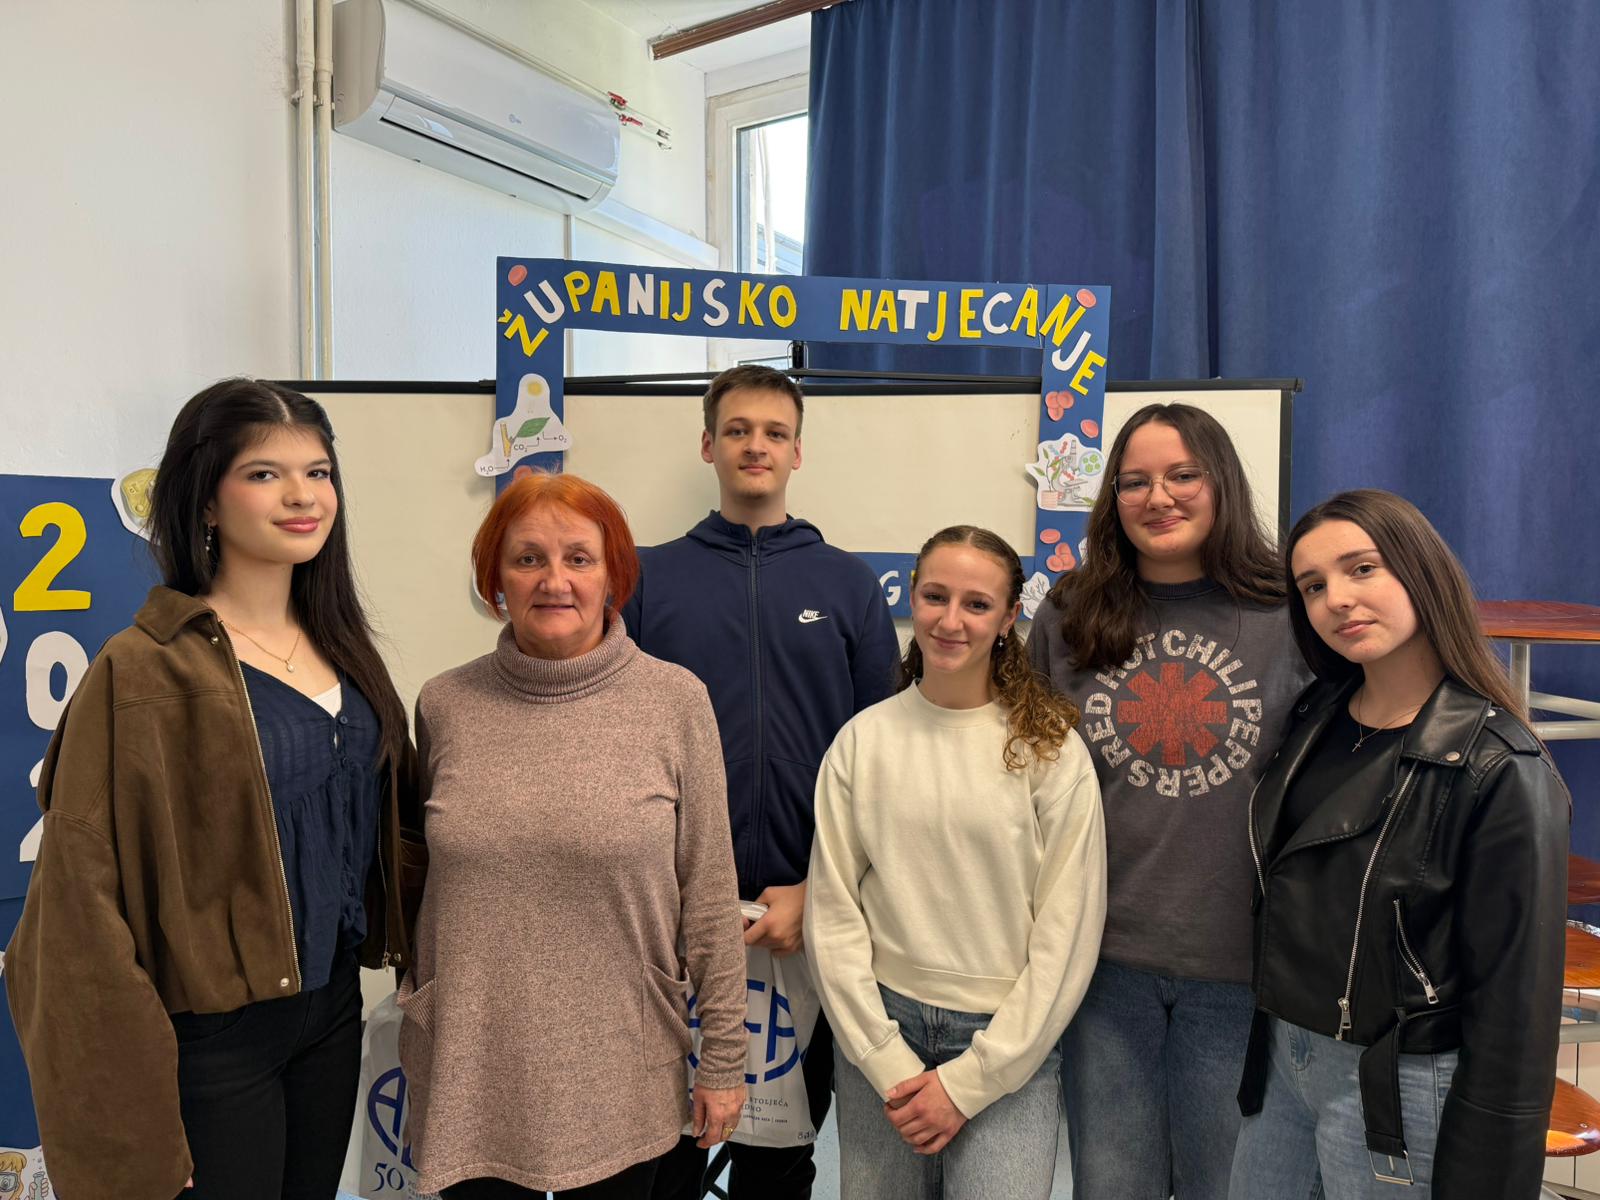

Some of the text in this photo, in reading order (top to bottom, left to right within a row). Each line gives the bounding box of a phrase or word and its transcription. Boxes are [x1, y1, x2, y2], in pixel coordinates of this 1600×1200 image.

[497, 271, 1107, 396] ŽUPANIJSKO NATJECANJE
[802, 609, 820, 619] NIKE
[1161, 629, 1258, 696] CHILI
[1085, 692, 1133, 769] RED
[1127, 698, 1263, 798] PEPPERS
[371, 1162, 405, 1192] 50
